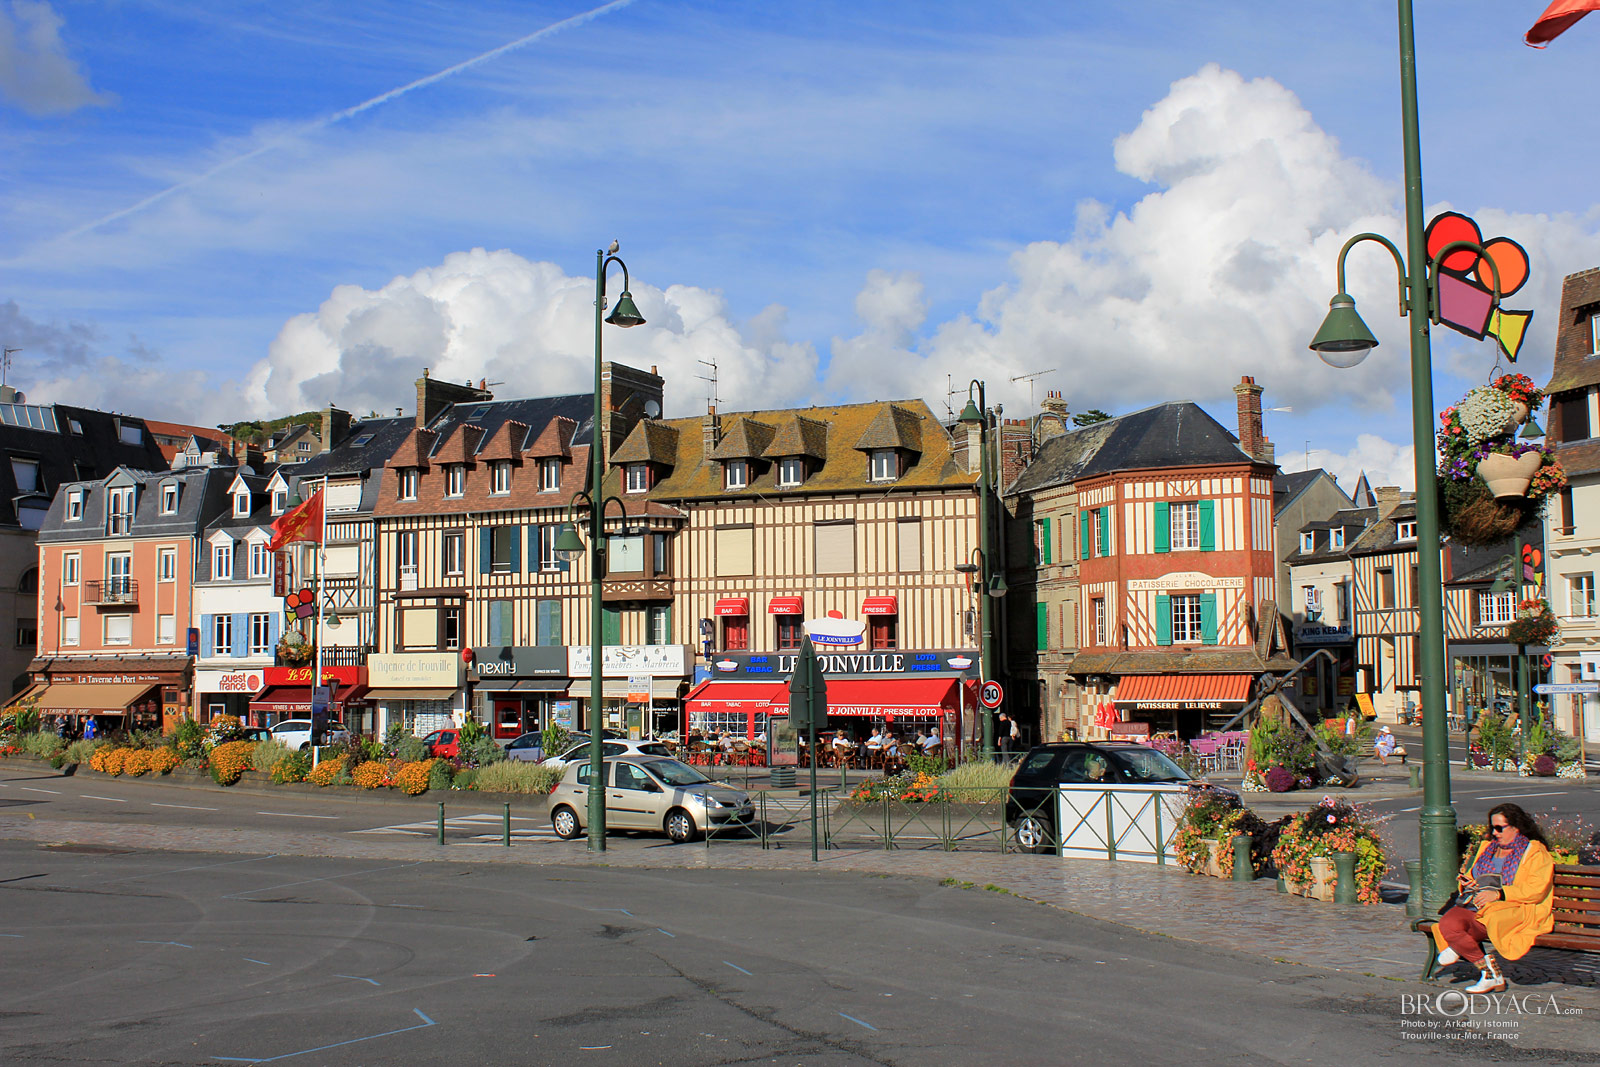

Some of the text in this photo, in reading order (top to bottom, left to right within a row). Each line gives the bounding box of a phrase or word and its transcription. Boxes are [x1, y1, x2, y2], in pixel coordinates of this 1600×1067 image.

[1303, 625, 1348, 636] KING KEBAB
[751, 656, 768, 664] BAR
[818, 654, 905, 673] OINVILLE
[915, 654, 936, 662] LOTO
[407, 660, 417, 672] de
[477, 661, 517, 674] nexity
[911, 663, 941, 672] PRESSE
[79, 675, 137, 684] La Taverne du Port
[221, 672, 246, 683] ouest
[286, 668, 299, 681] Le
[219, 680, 246, 691] france
[984, 689, 998, 700] 30
[836, 706, 882, 715] JOINVILLE
